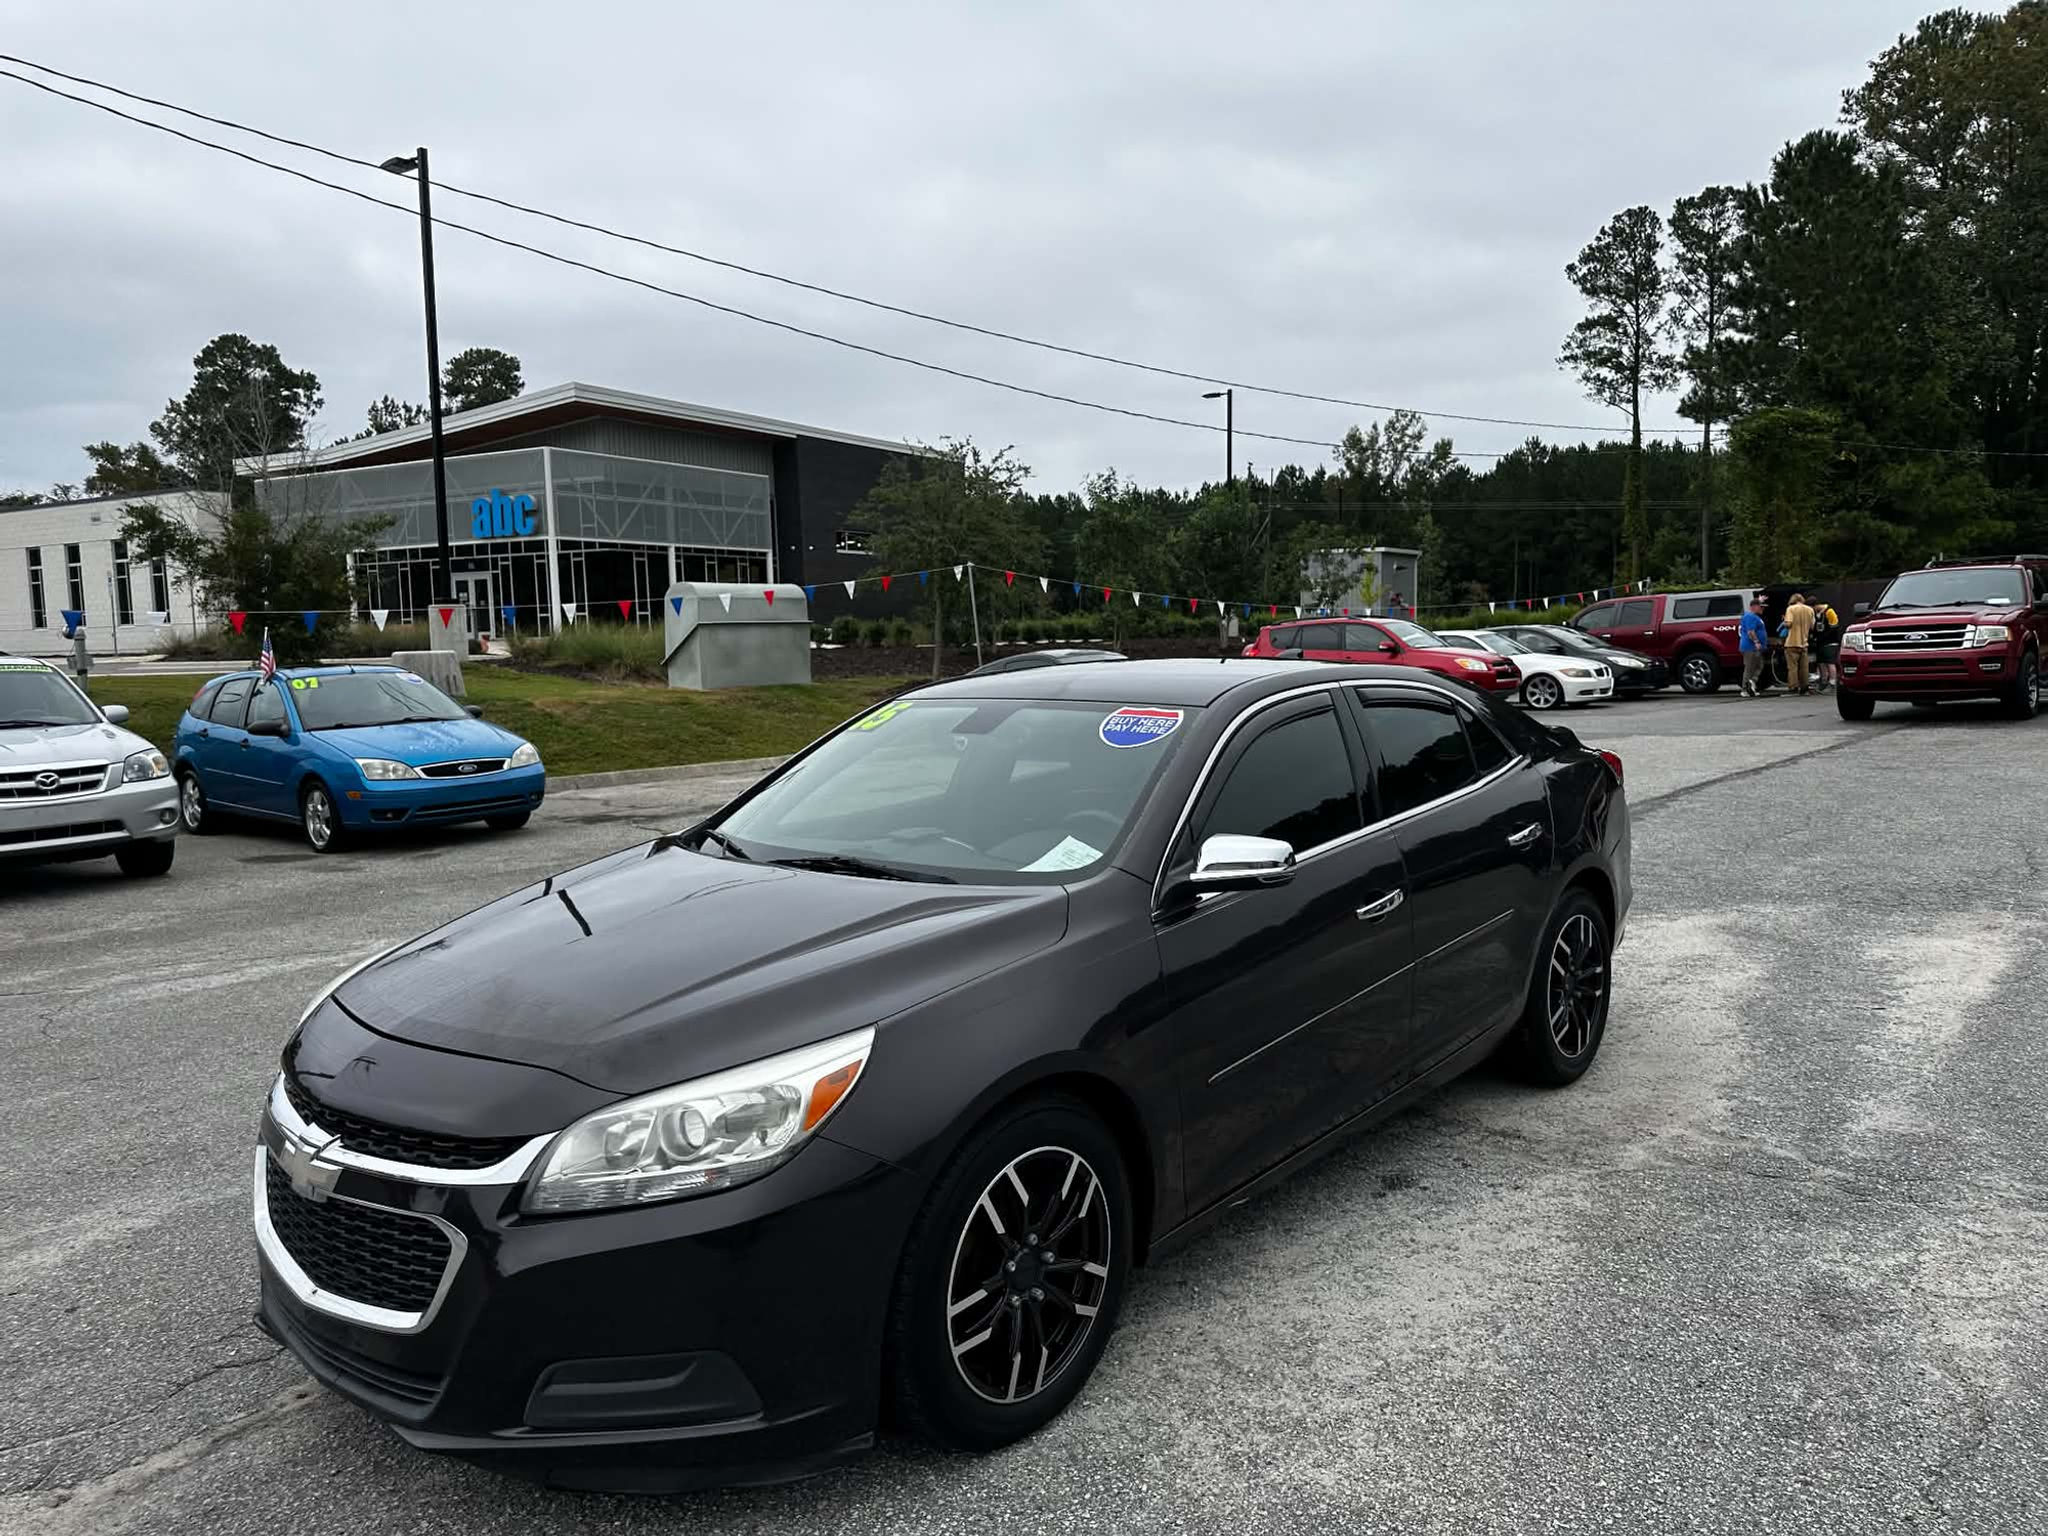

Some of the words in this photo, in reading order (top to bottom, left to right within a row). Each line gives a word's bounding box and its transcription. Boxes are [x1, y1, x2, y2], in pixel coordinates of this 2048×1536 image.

[472, 488, 535, 539] abc
[292, 677, 319, 690] 07
[1108, 716, 1136, 728] BUY
[1138, 718, 1176, 727] HERE
[1104, 723, 1130, 732] PAY
[1130, 725, 1170, 734] HERE
